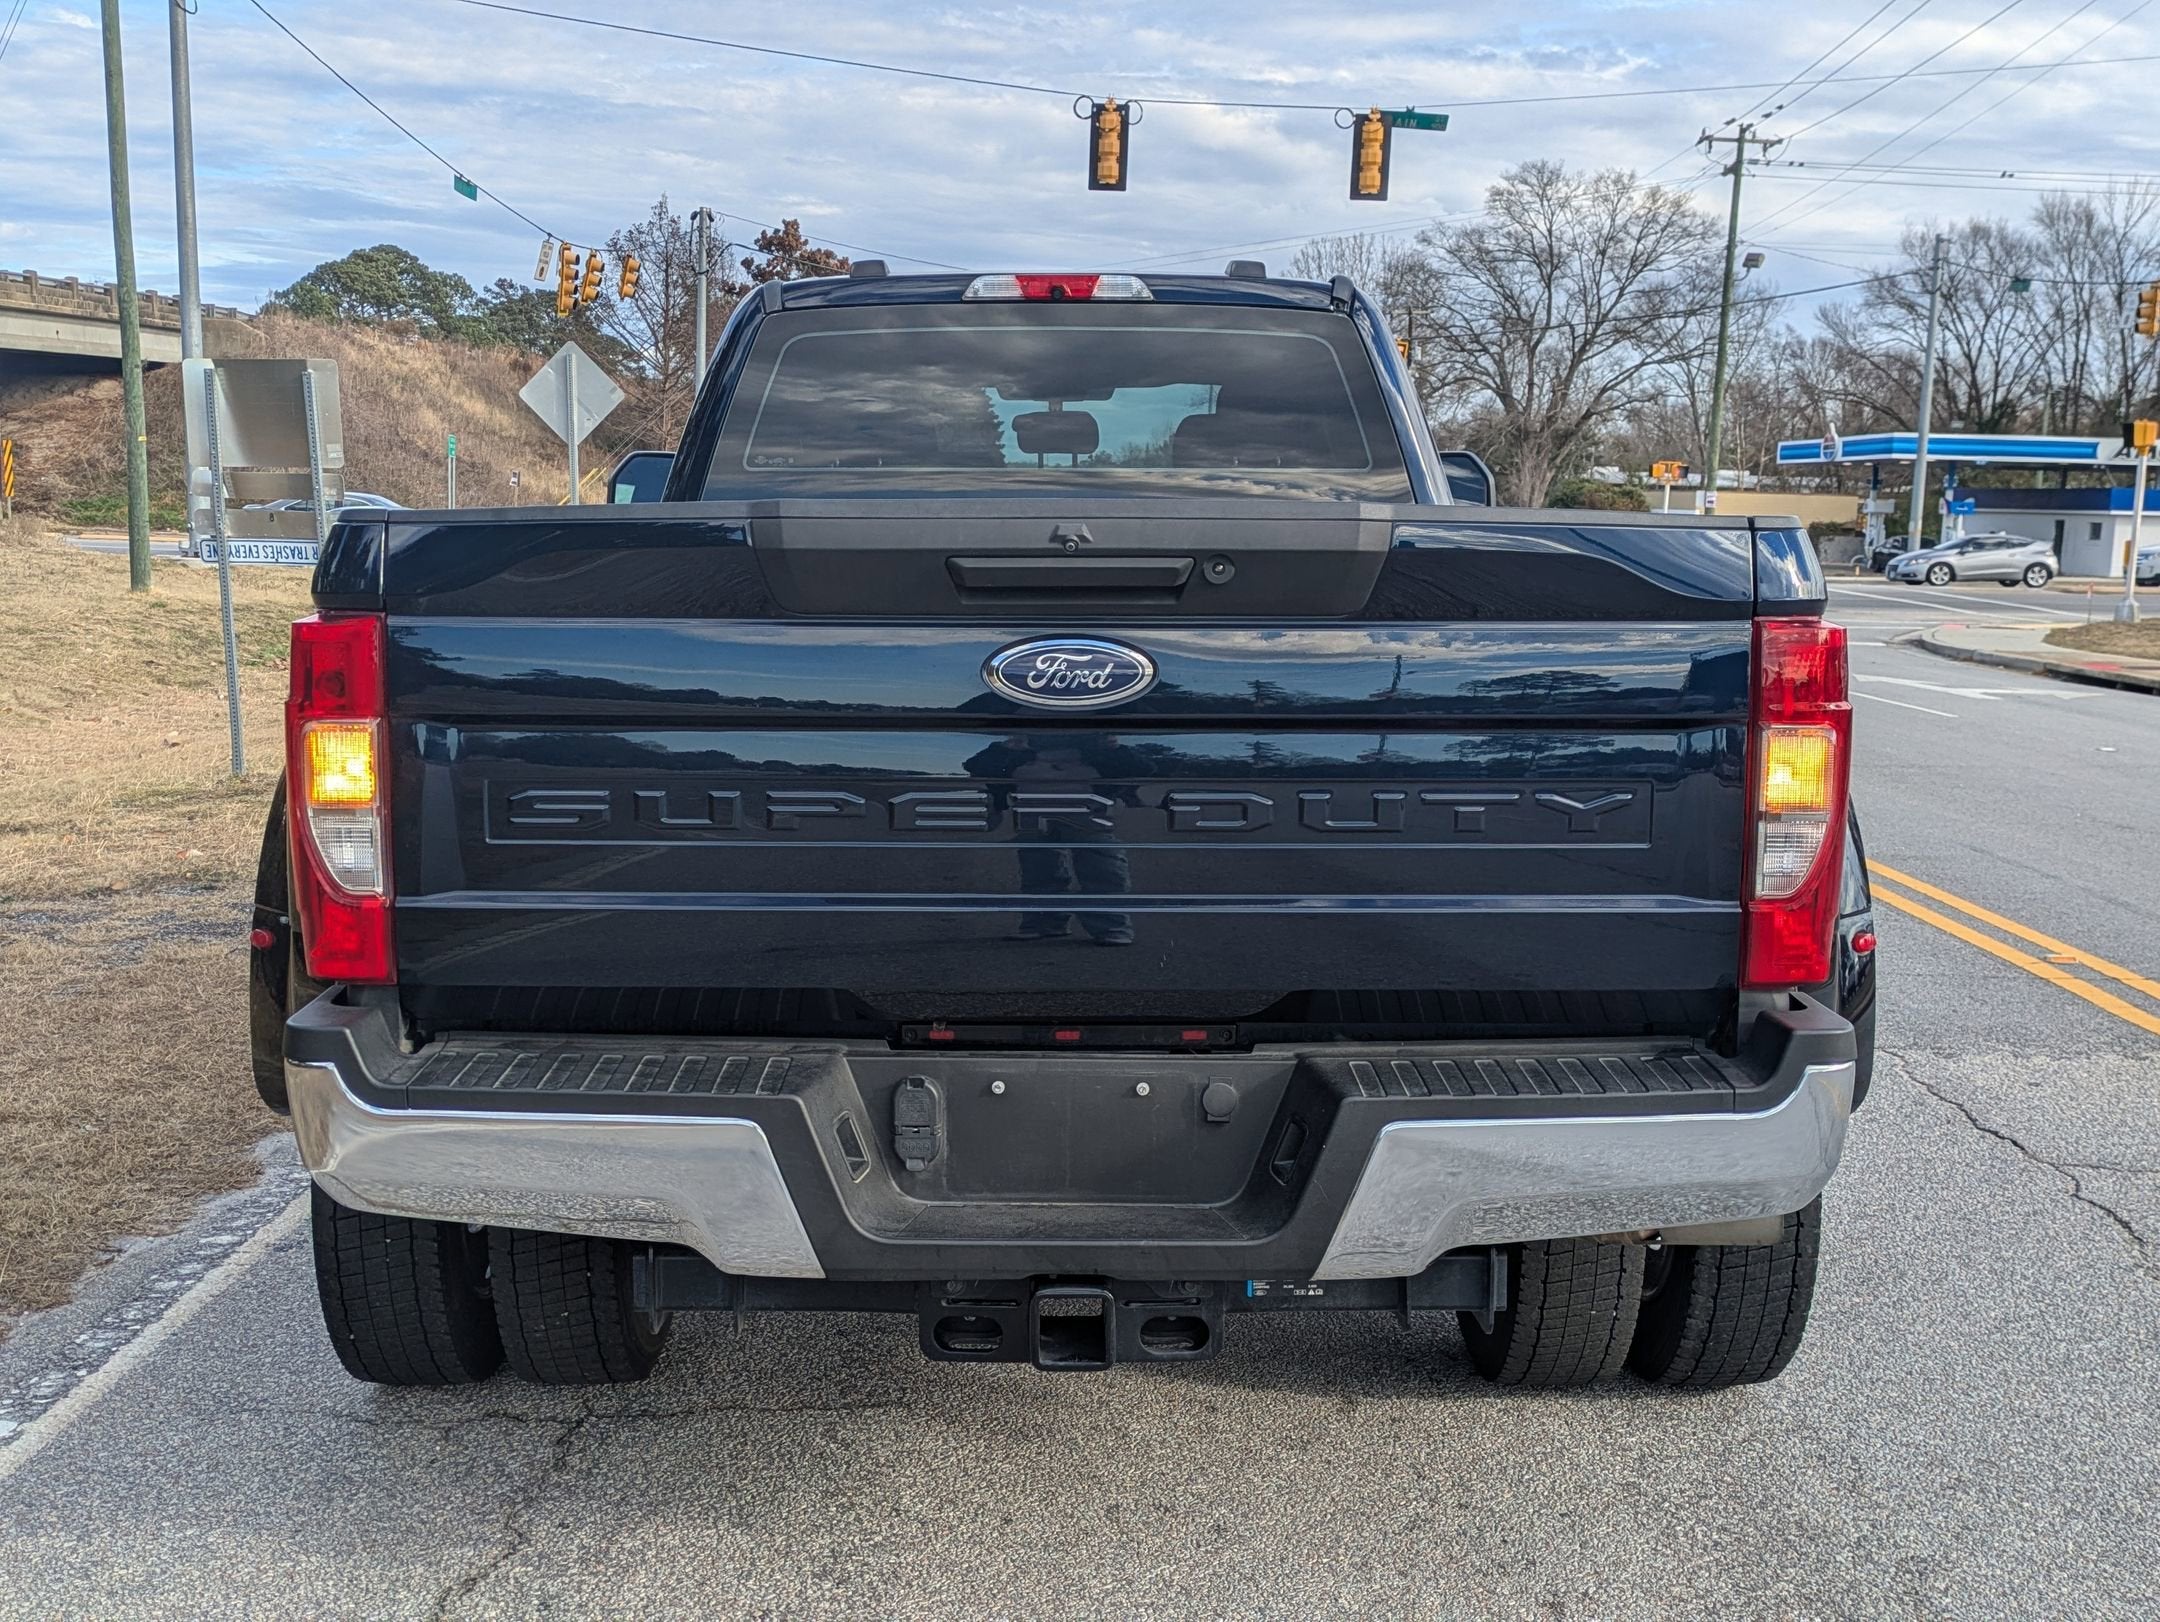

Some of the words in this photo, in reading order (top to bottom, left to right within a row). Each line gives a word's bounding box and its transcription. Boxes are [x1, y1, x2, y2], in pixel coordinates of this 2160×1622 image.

[205, 544, 260, 559] EVERYNE
[262, 544, 310, 561] TRASHES
[1026, 653, 1114, 689] Ford
[508, 790, 1115, 833] SUPER
[1167, 791, 1634, 834] DUTY
